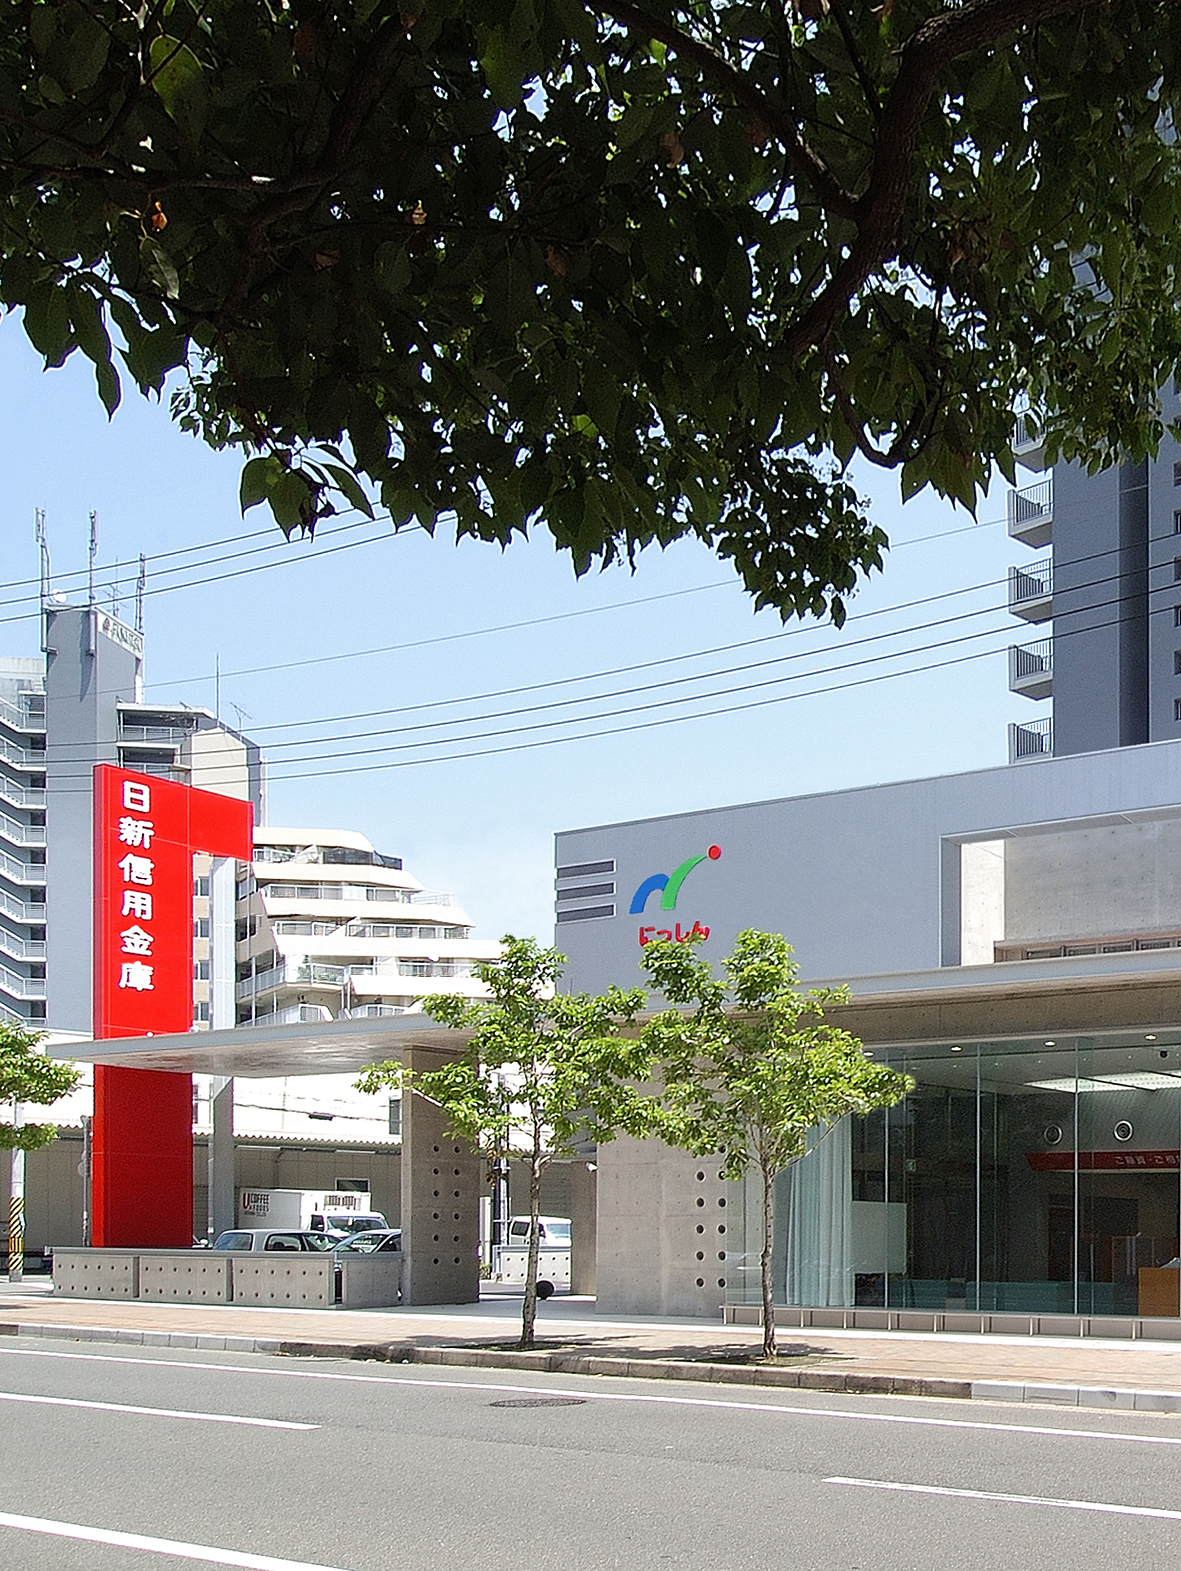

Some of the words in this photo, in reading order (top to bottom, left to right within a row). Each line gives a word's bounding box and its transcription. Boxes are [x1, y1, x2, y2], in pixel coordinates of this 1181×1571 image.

[118, 780, 155, 991] 日新信用金庫
[639, 920, 711, 946] にっしん
